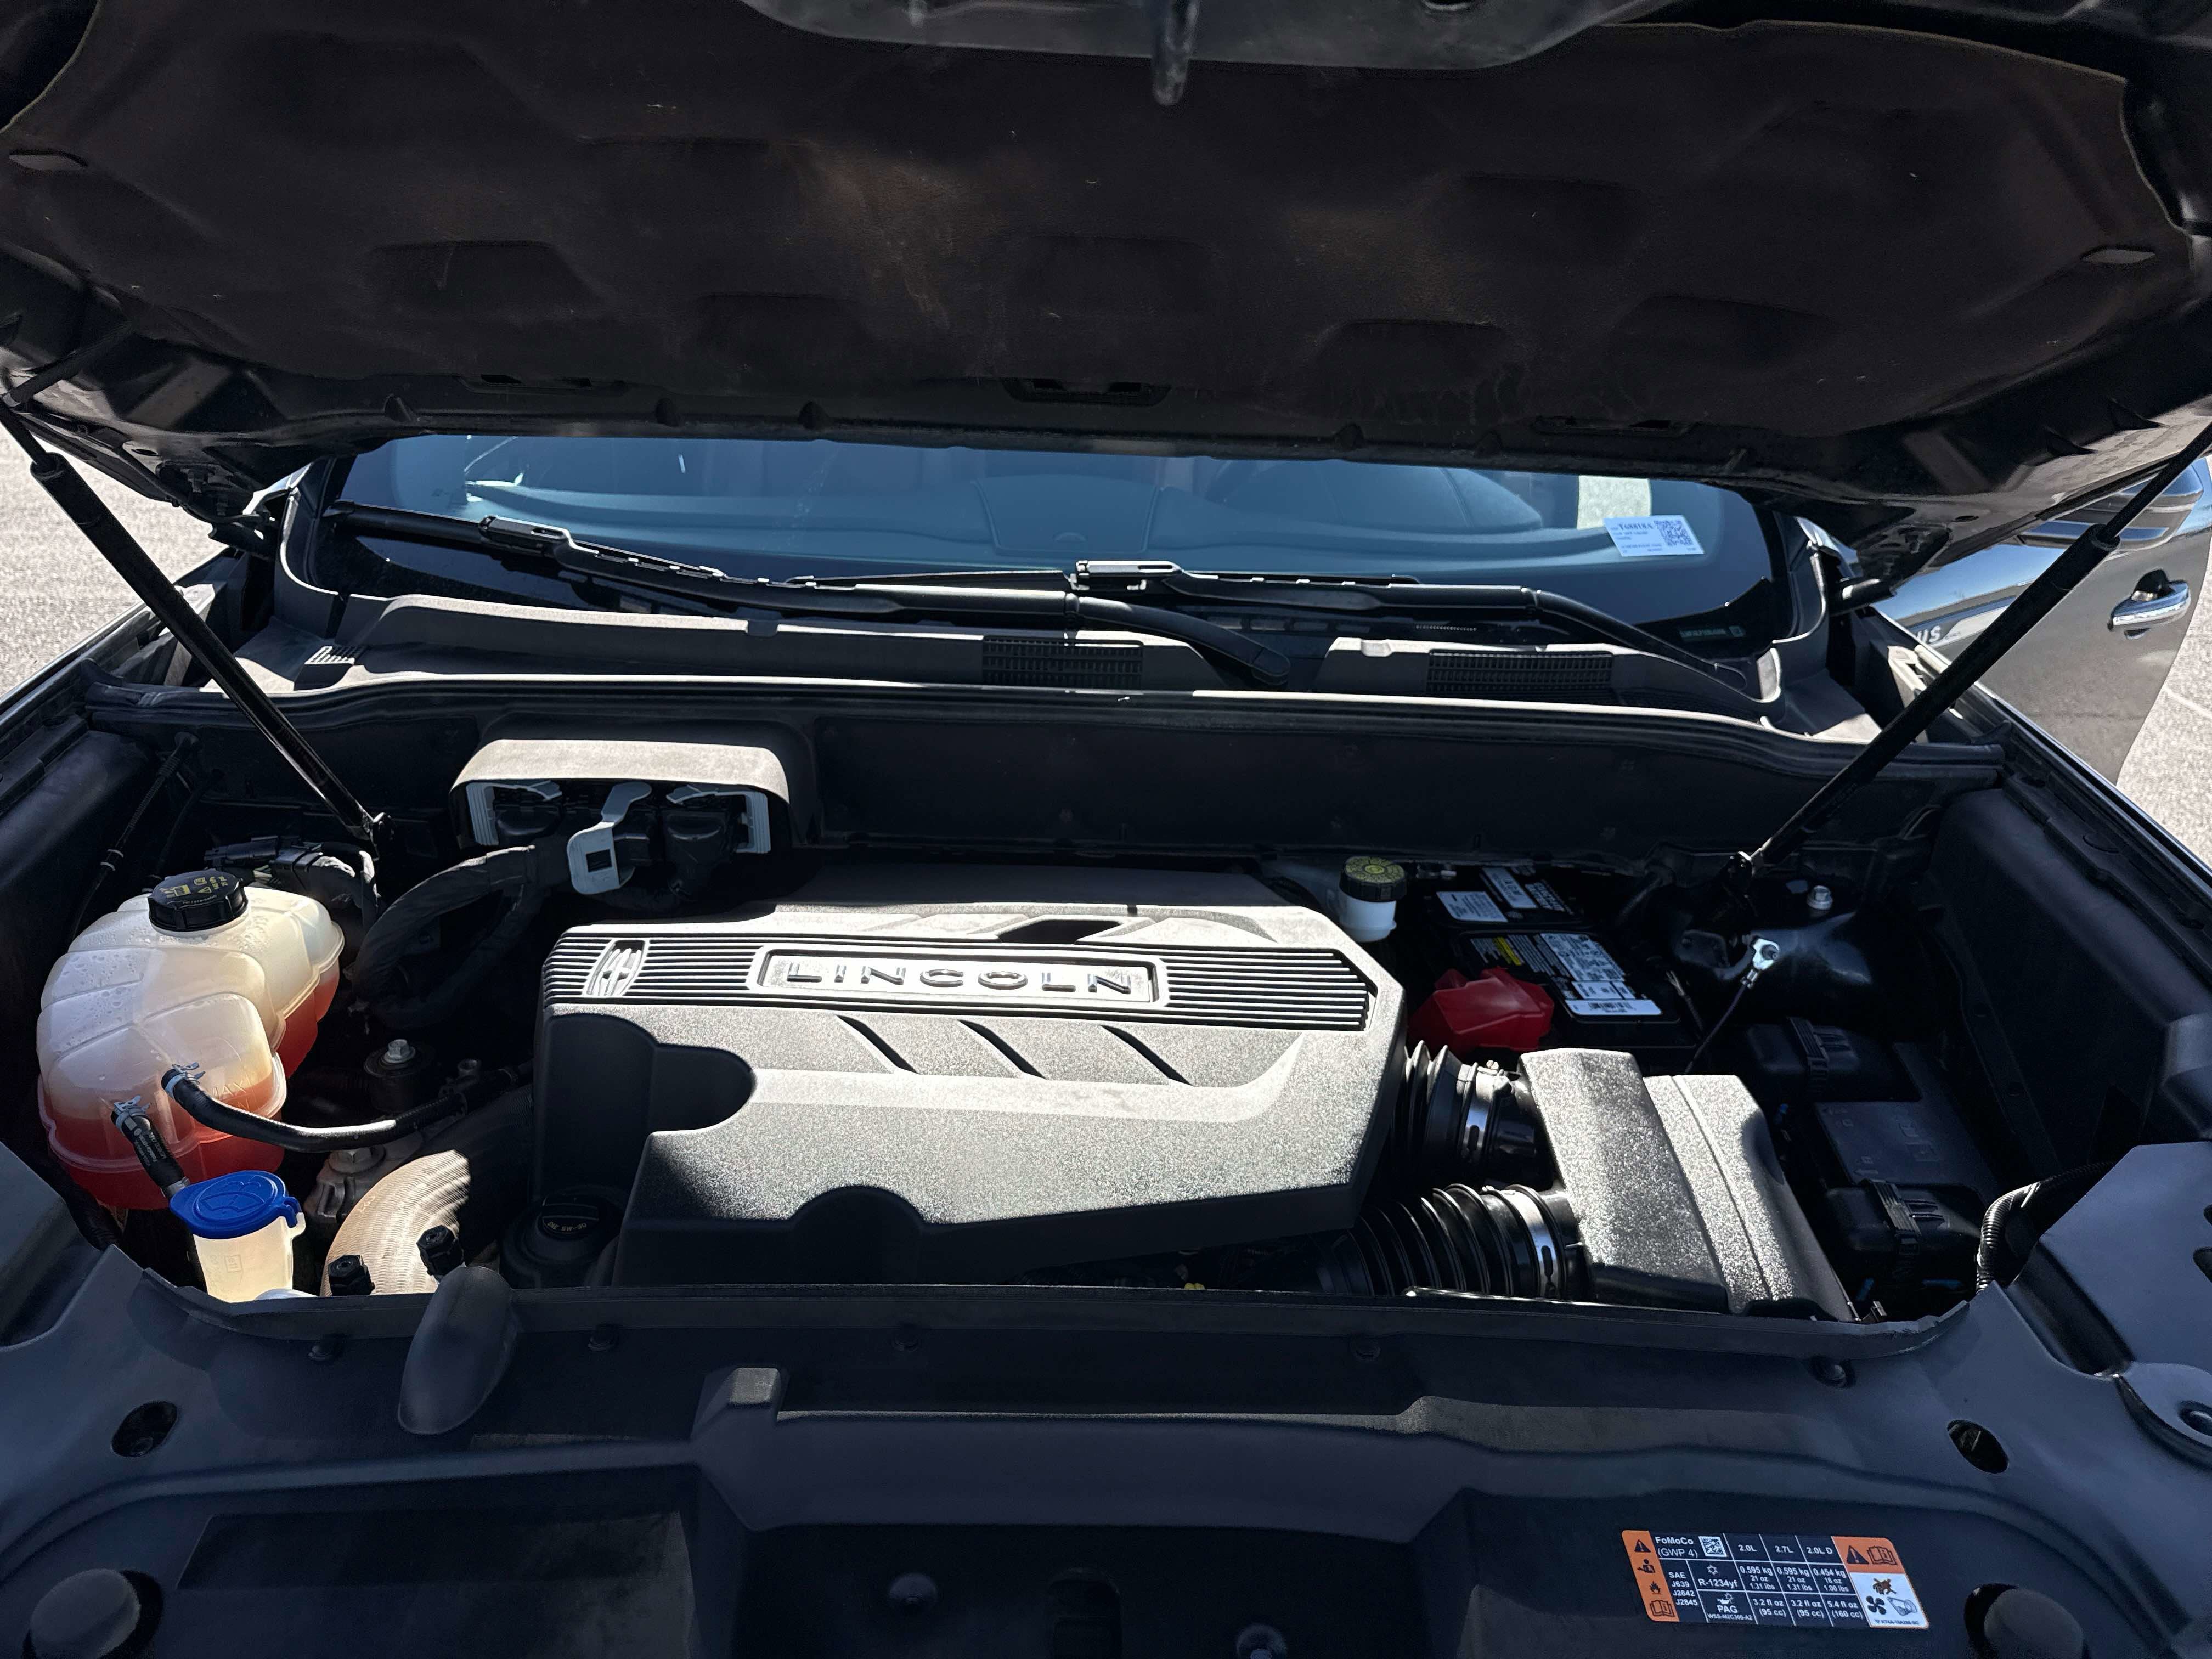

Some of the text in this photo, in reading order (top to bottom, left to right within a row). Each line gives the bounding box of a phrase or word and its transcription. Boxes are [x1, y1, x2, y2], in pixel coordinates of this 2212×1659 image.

[786, 961, 1131, 995] LINCOLN
[1655, 1536, 1694, 1545] FoMoCo
[1657, 1548, 1698, 1558] (GWP 4)
[1739, 1566, 1773, 1576] 0.595 kg
[1798, 1568, 1810, 1577] kg
[1813, 1568, 1847, 1578] 0.454 kg
[1698, 1578, 1738, 1589] R-1234yf
[1717, 1605, 1738, 1613] PAG
[1759, 1608, 1786, 1617] (95 cc)
[1797, 1609, 1824, 1618] (95 cc)
[1831, 1610, 1863, 1620] (160 cc)
